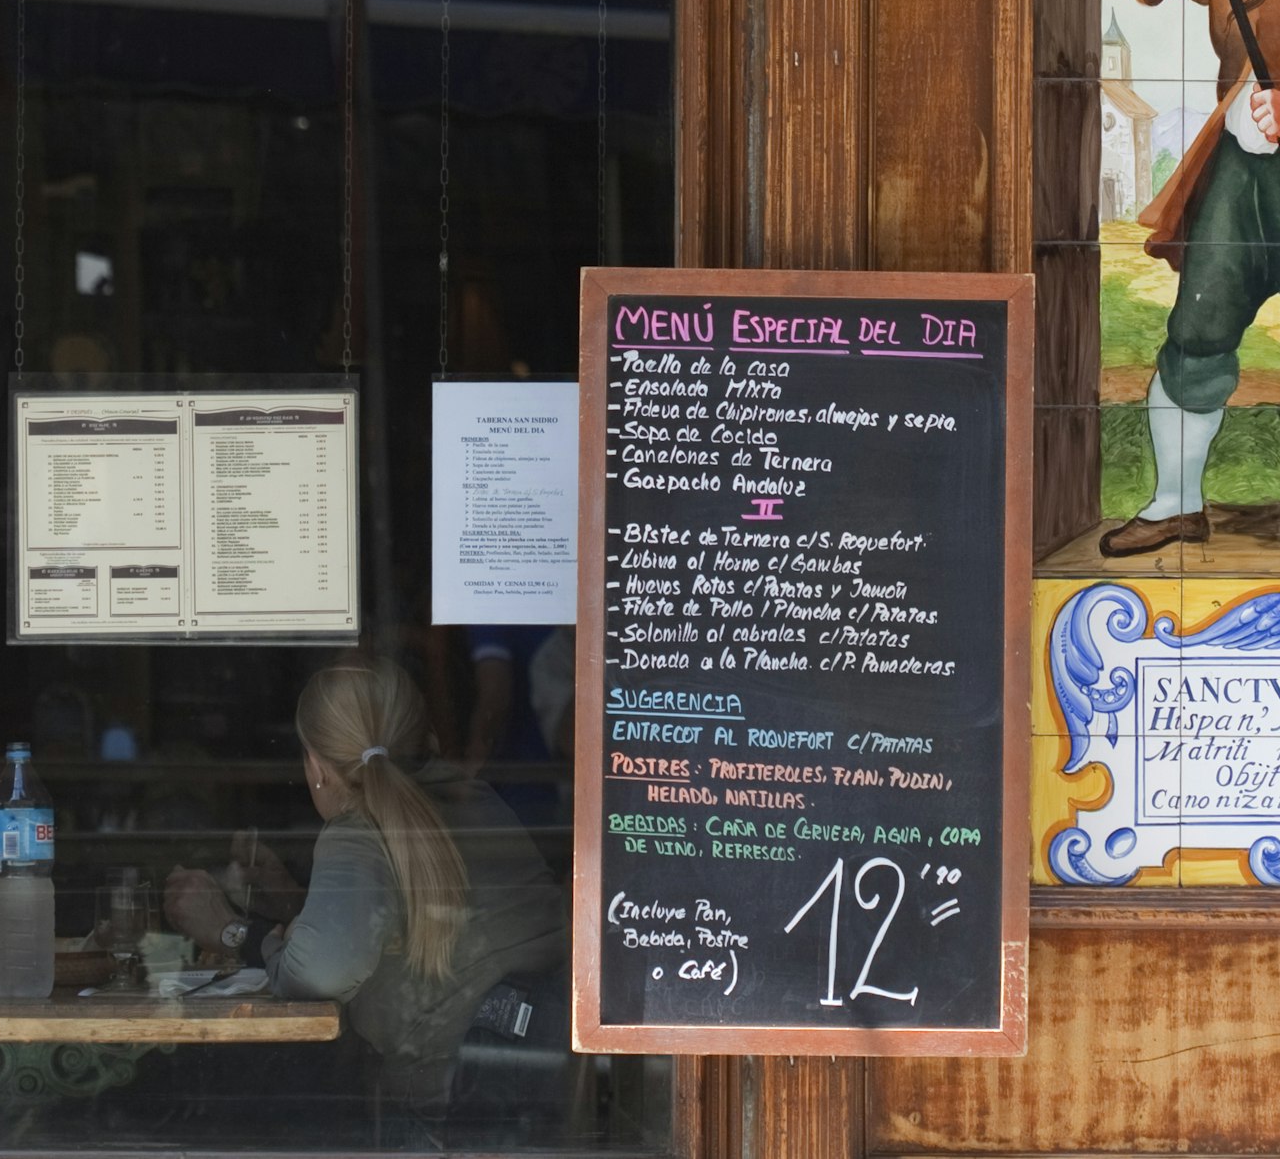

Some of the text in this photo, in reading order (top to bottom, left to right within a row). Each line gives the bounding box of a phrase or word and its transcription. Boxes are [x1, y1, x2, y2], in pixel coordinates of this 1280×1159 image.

[614, 302, 977, 348] MENÚ ESPECIAL DEL DIA
[606, 688, 743, 714] SUGERENCIA
[612, 720, 703, 743] ENTRECOT
[714, 726, 738, 746] AL
[748, 730, 835, 751] ROQUEFORT
[1144, 736, 1248, 762] Matriti
[705, 815, 758, 838] CAÑA
[764, 823, 788, 840] DE
[939, 825, 982, 847] COPA
[624, 837, 648, 854] DE
[695, 899, 732, 925] Pan,
[697, 927, 749, 950] Postre
